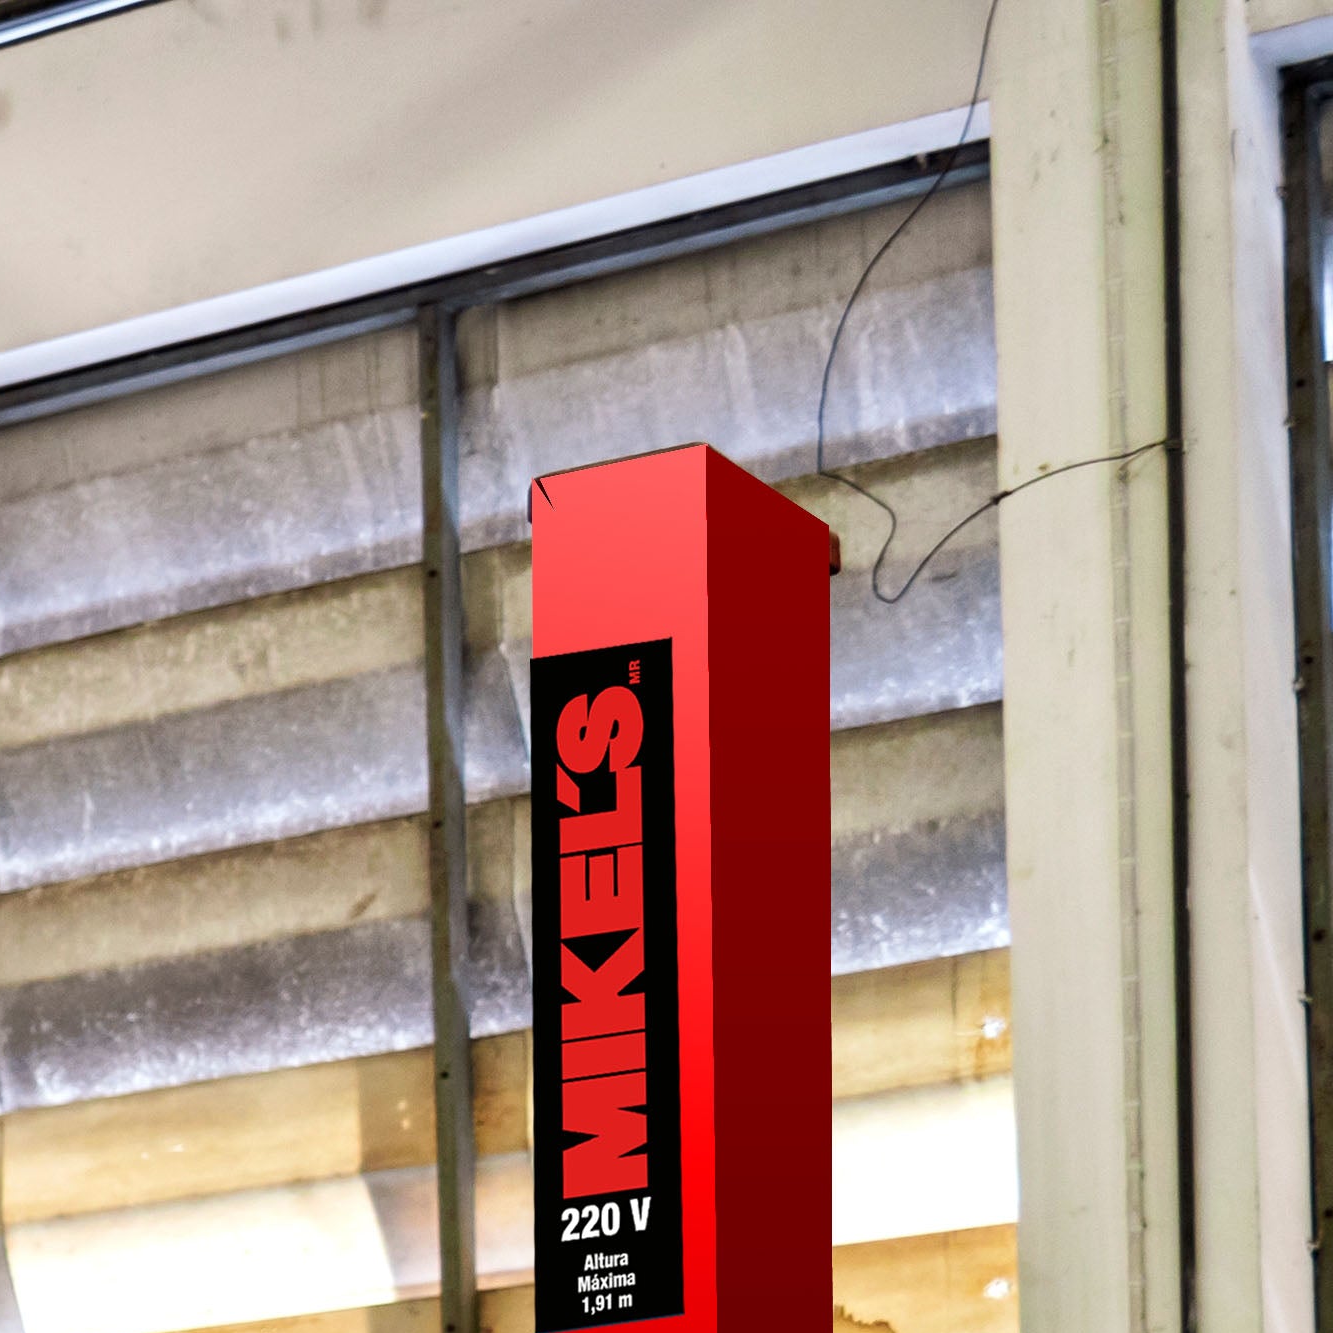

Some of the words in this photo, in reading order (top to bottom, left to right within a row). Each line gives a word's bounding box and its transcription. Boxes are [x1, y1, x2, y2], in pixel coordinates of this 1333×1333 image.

[556, 686, 649, 1199] MIKEL'S
[629, 660, 640, 684] MR
[561, 1202, 620, 1242] 220
[630, 1196, 652, 1231] V
[584, 1252, 629, 1271] Altura
[577, 1272, 636, 1293] Máxima
[582, 1293, 612, 1315] 1,91
[618, 1294, 633, 1308] m
